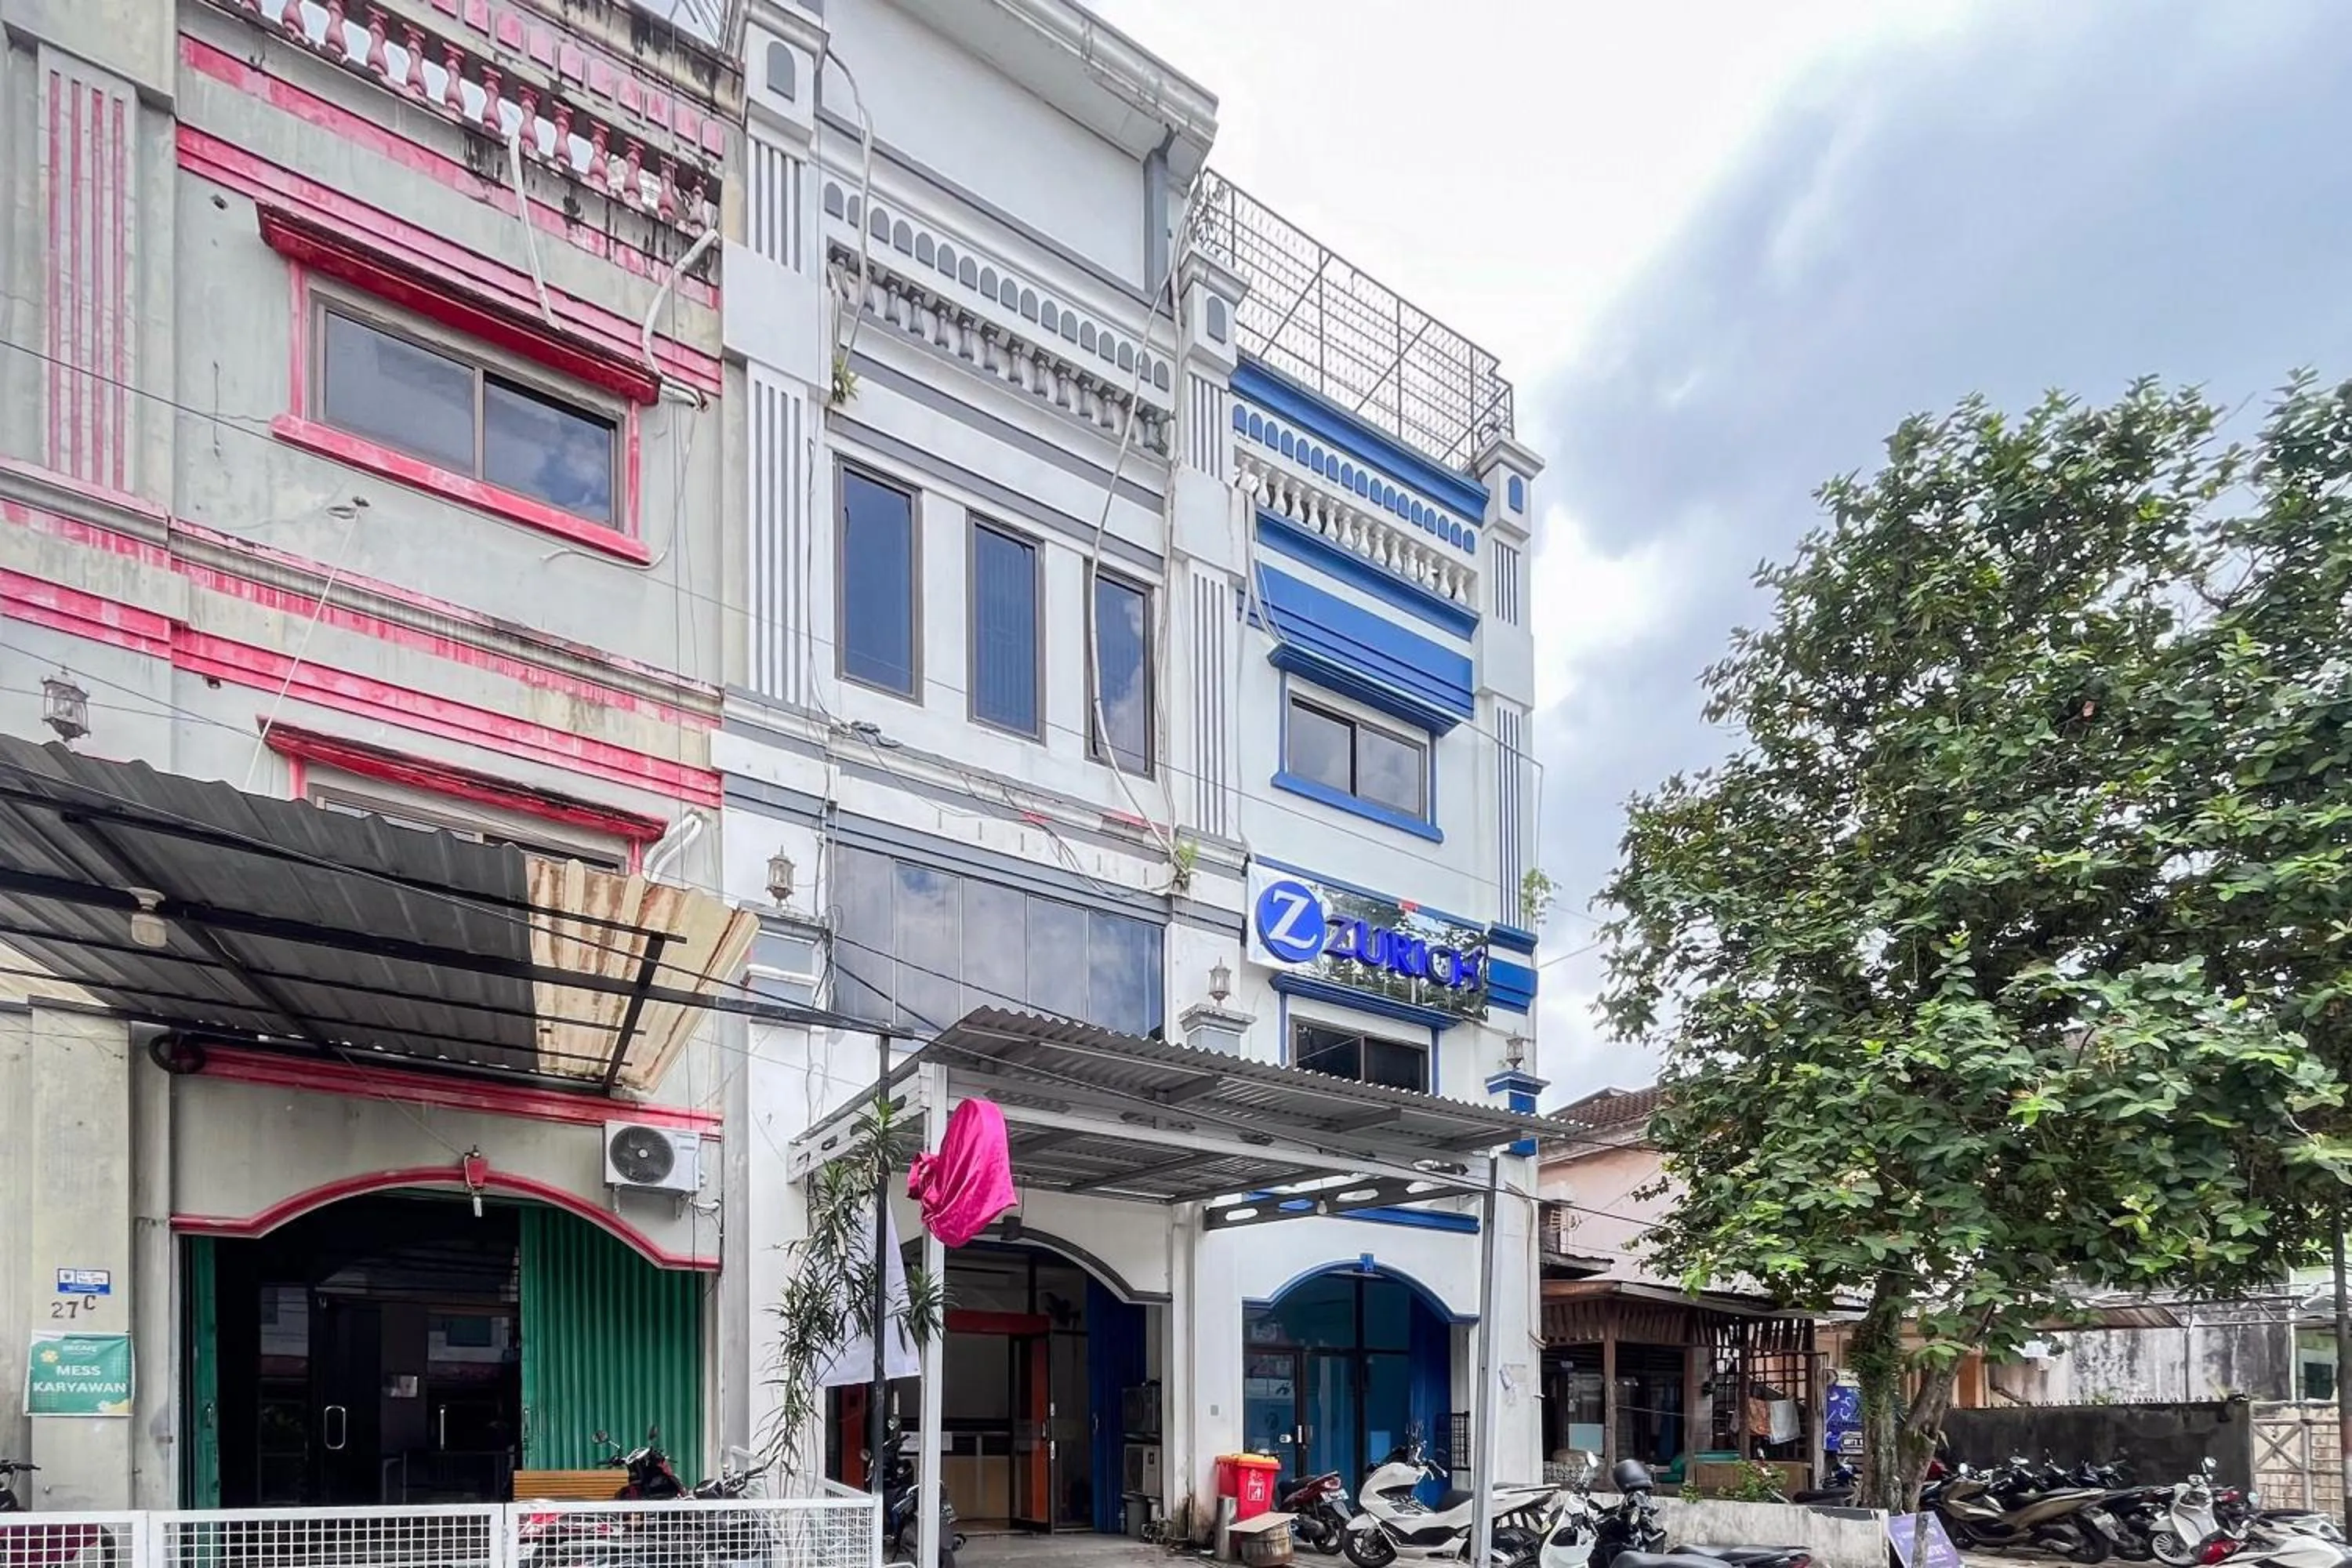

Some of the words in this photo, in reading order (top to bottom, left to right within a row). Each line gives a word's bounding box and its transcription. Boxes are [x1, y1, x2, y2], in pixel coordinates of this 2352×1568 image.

[1269, 890, 1318, 949] Z
[1323, 913, 1483, 991] ZURICH
[56, 1365, 101, 1376] MESS
[32, 1381, 126, 1393] KARYAWAN
